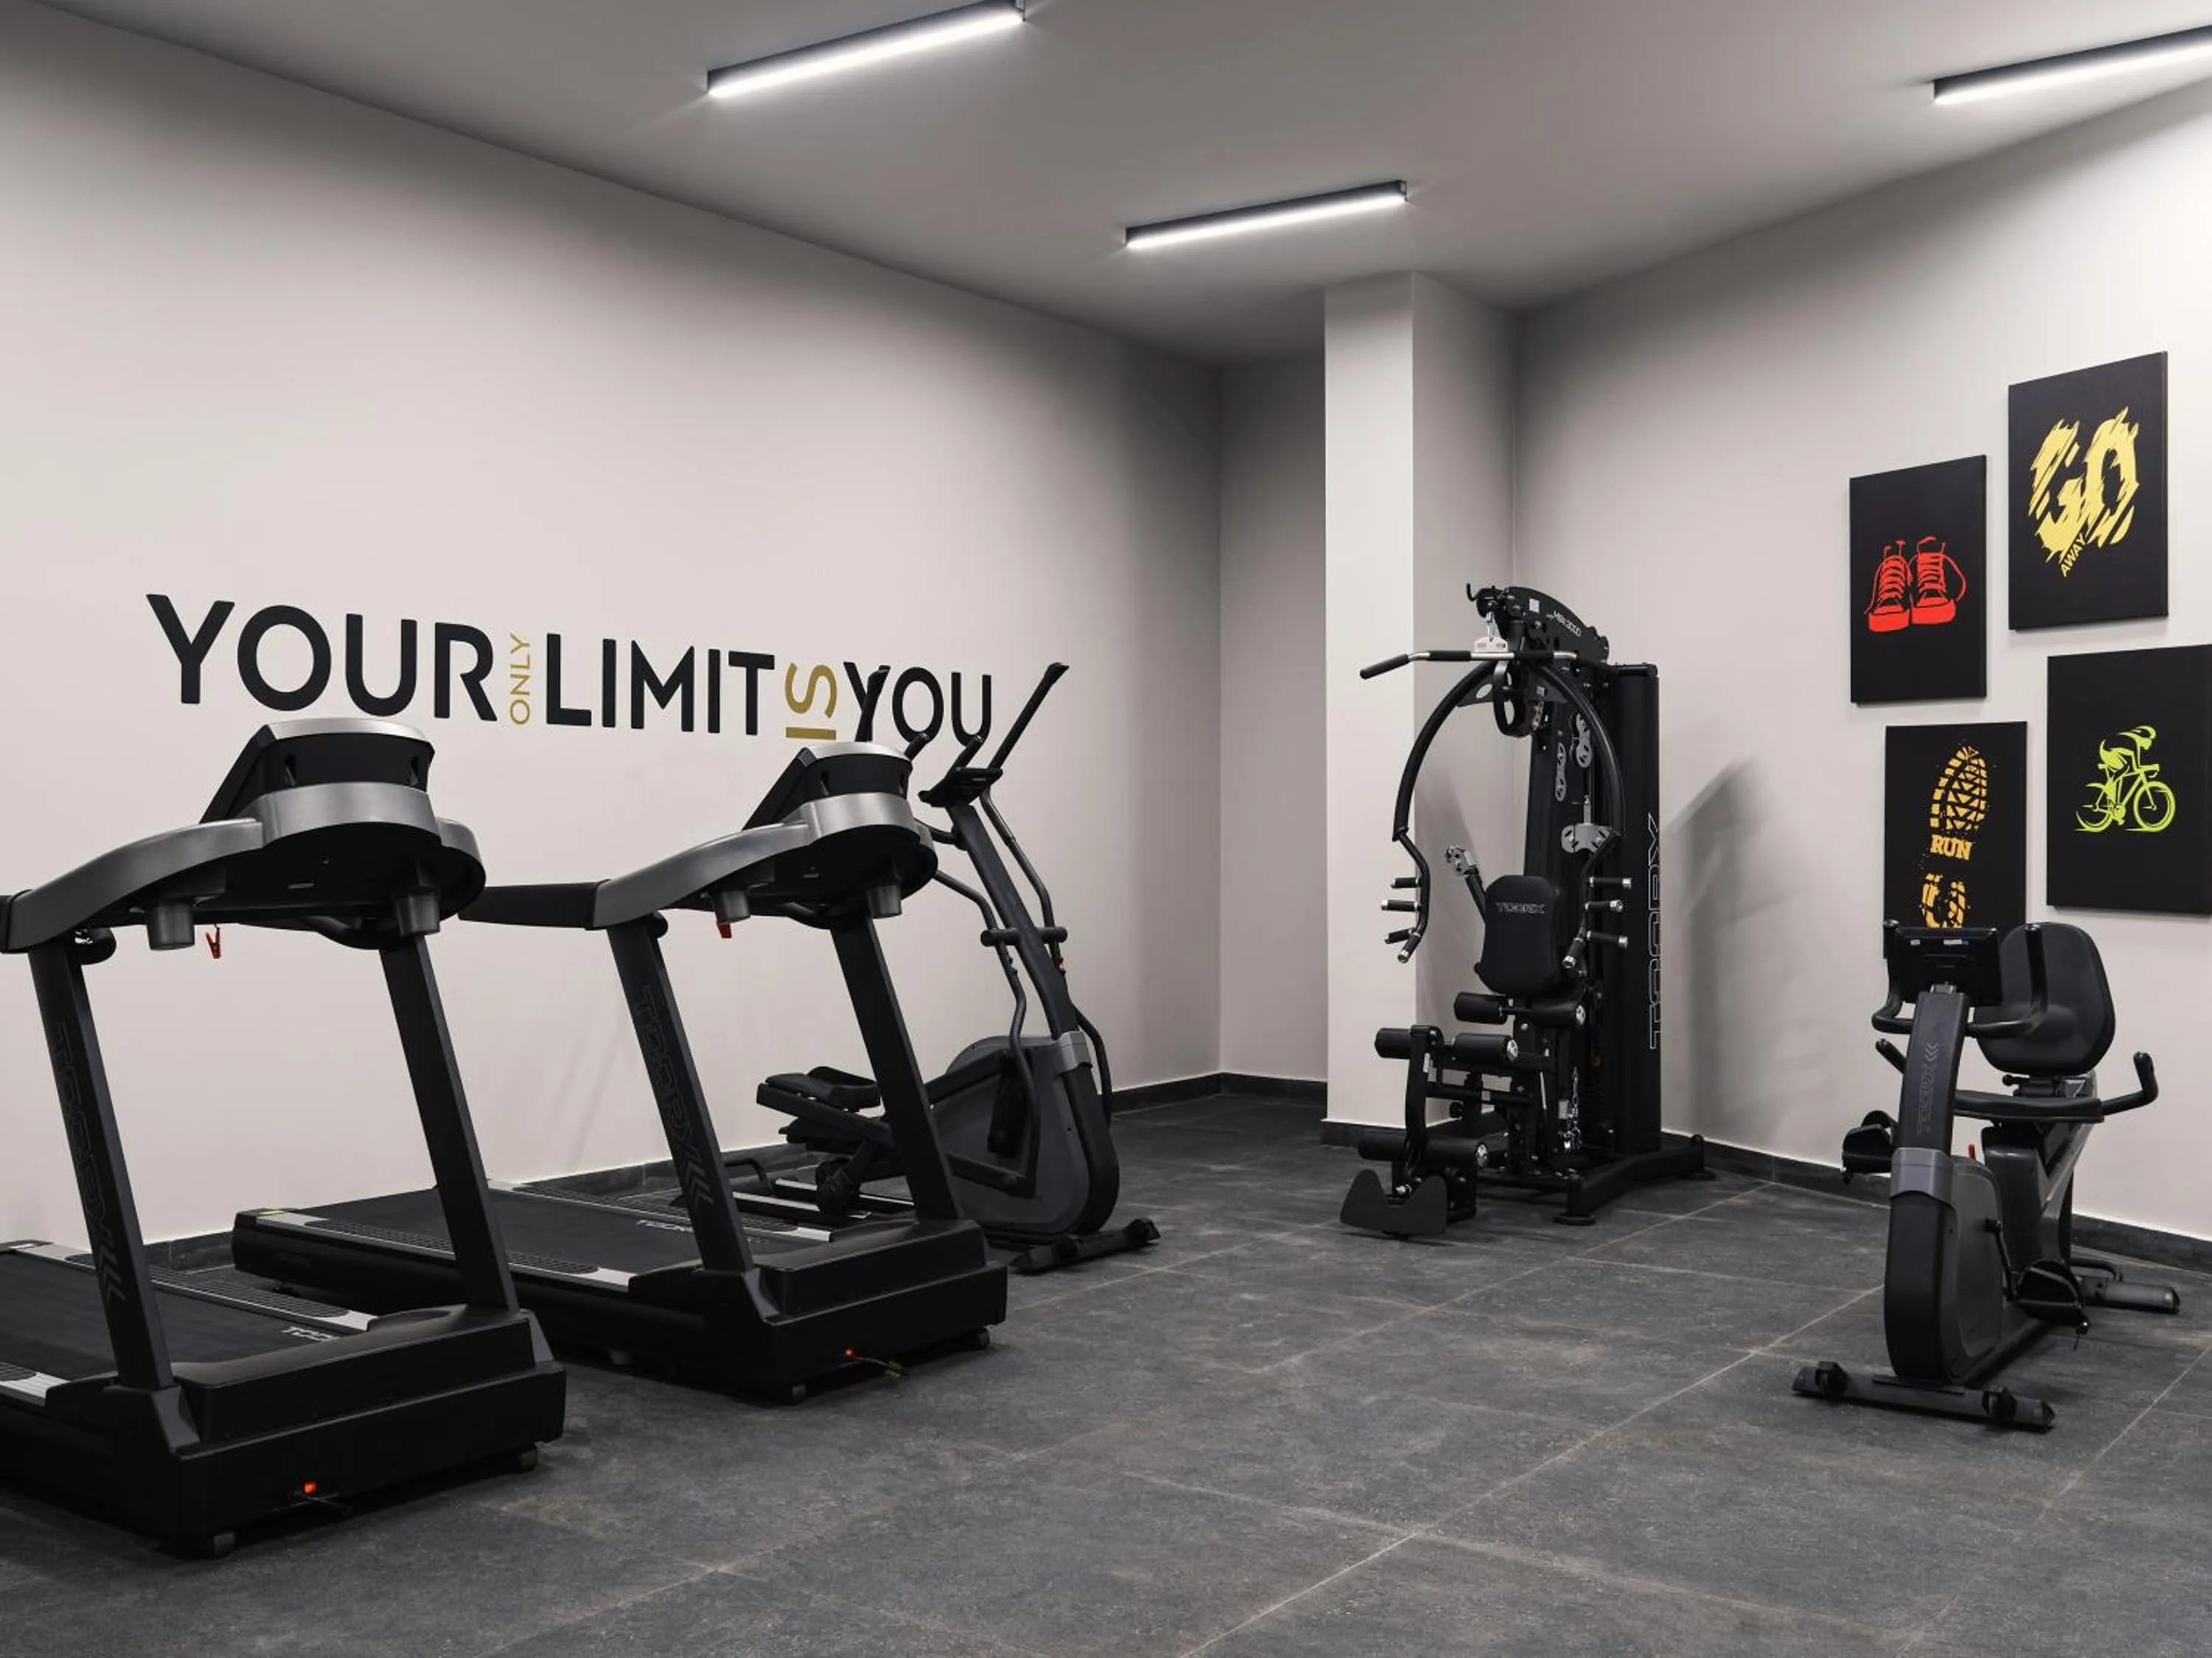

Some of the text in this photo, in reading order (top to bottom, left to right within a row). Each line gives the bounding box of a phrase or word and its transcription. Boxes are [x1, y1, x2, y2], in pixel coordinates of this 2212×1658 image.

[2028, 405, 2140, 563] GO
[2061, 532, 2086, 577] AWAY
[146, 594, 498, 722] YOUR
[509, 632, 532, 726] ONLY
[546, 633, 775, 736] LIMIT
[785, 662, 838, 740] IS
[1930, 833, 1974, 861] RUN
